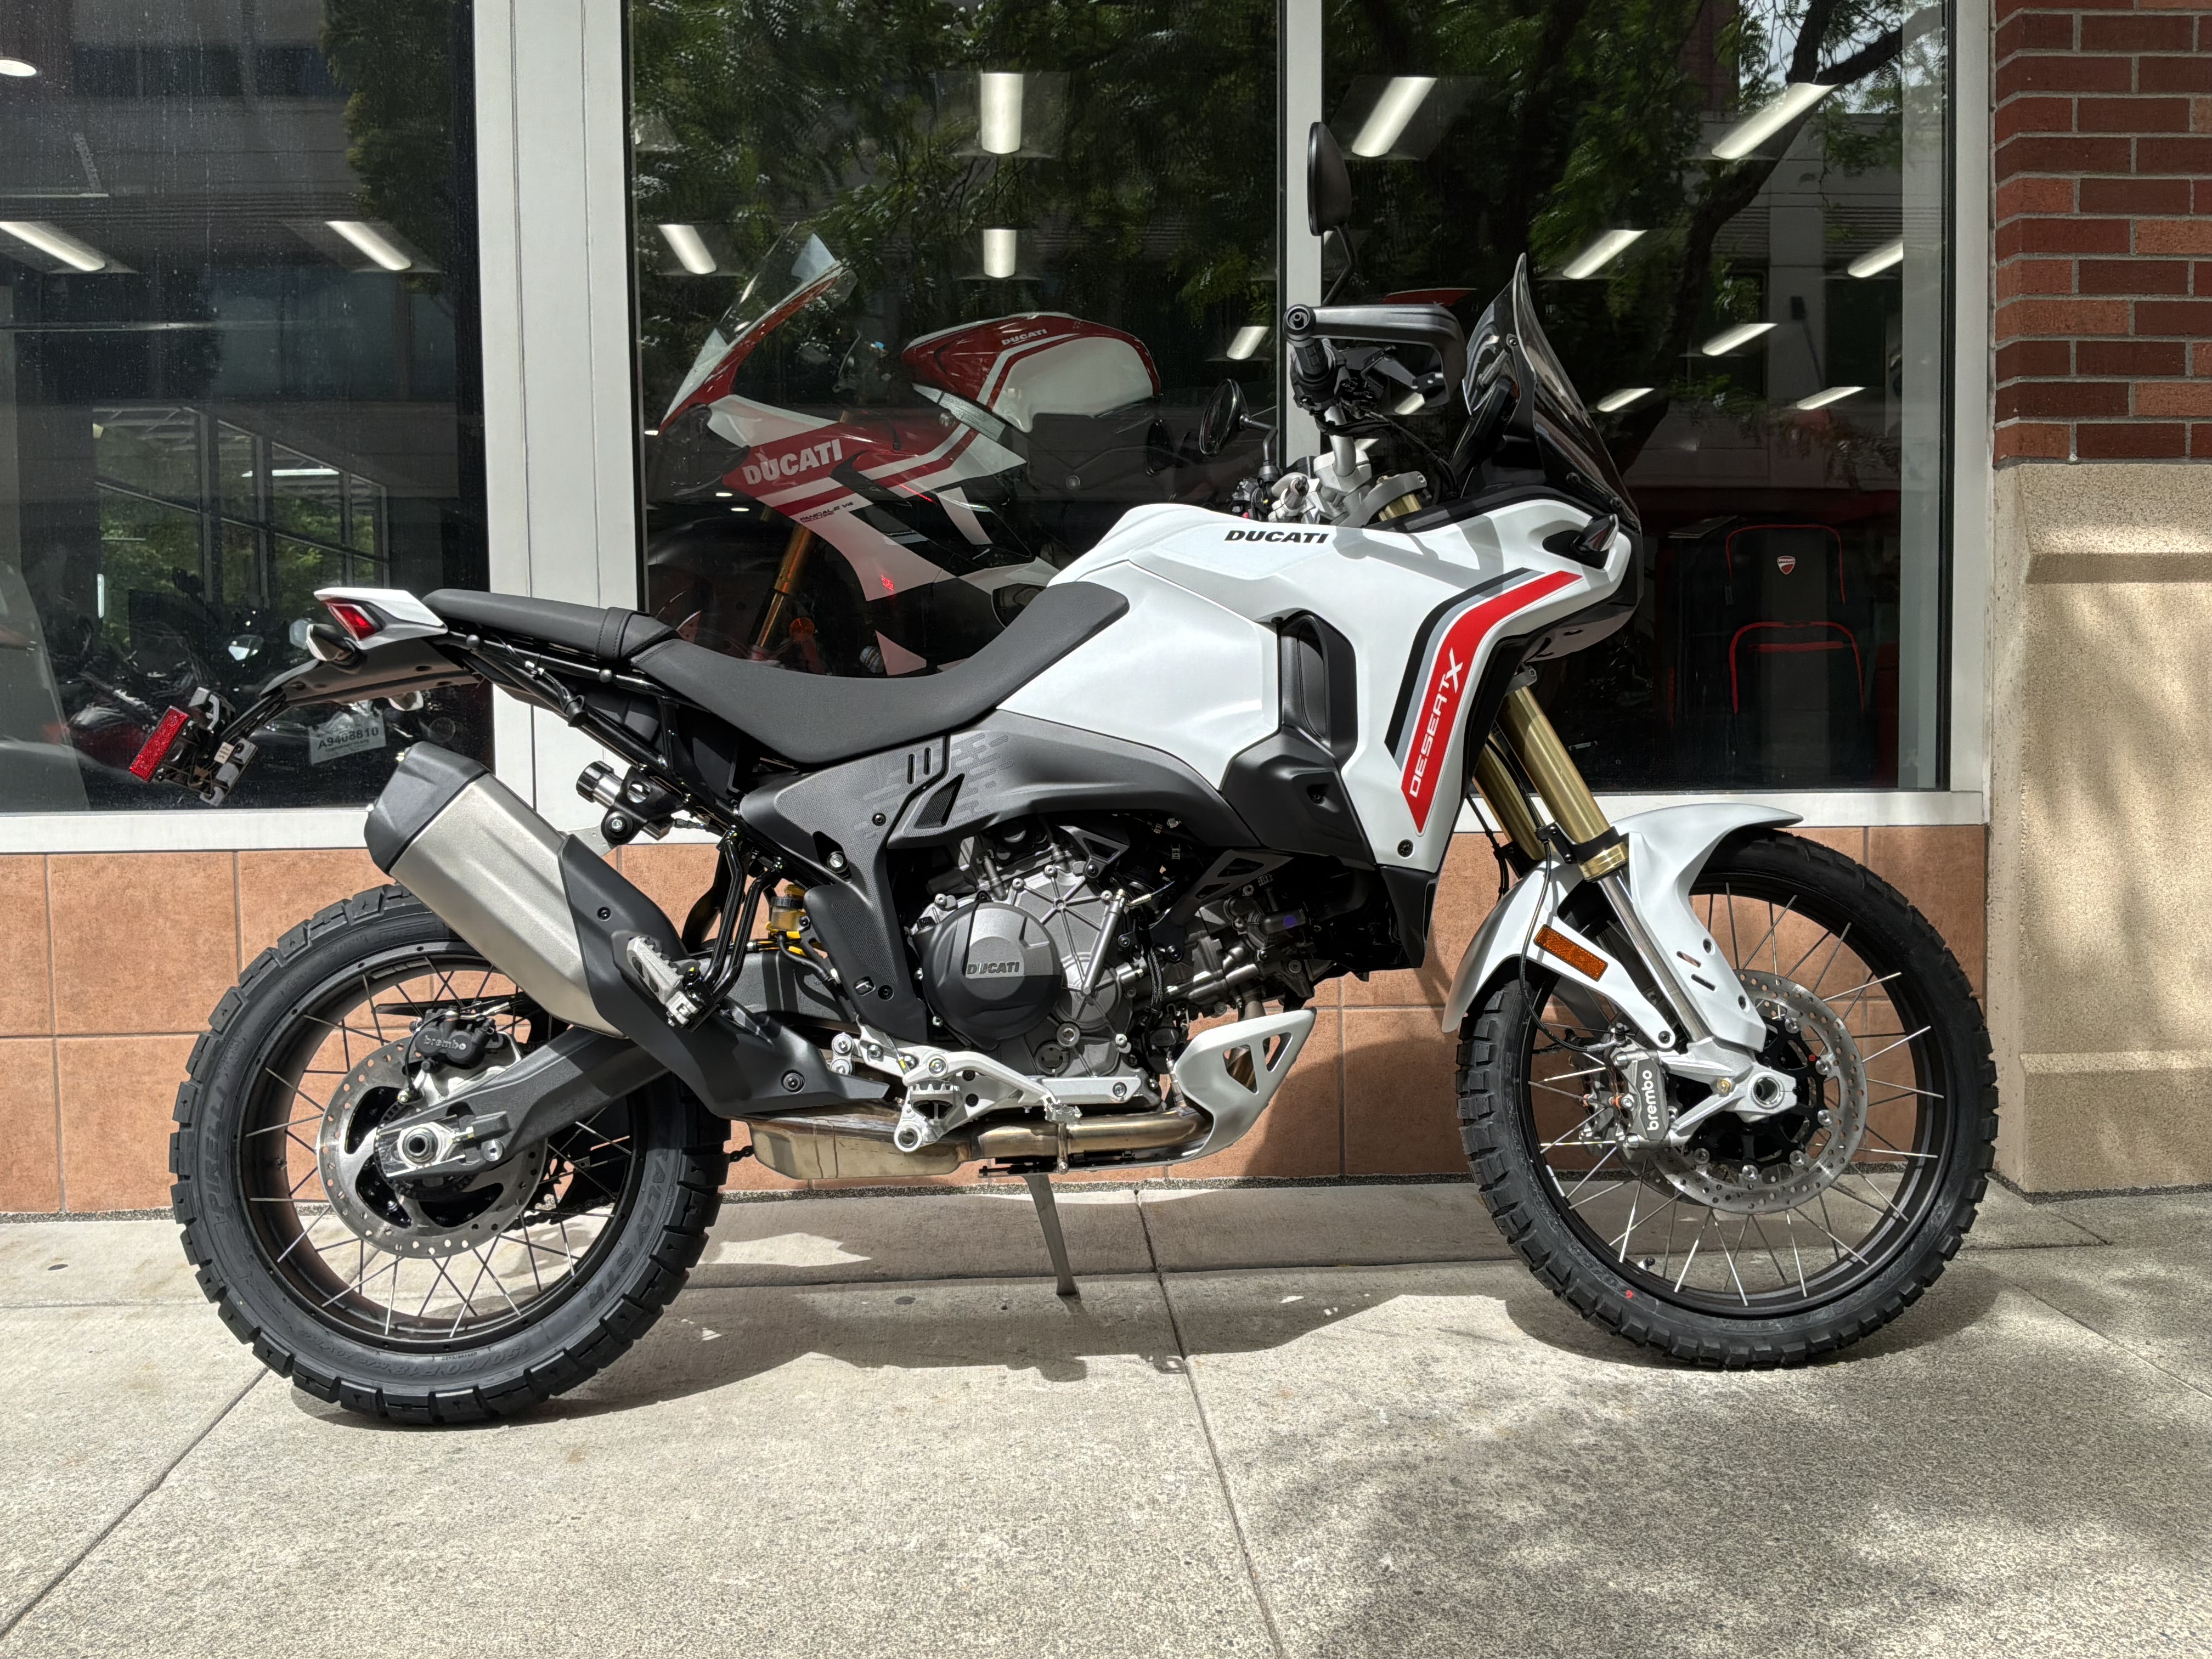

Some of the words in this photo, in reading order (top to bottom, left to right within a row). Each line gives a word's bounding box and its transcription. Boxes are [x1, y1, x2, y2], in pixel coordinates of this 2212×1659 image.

[1001, 329, 1047, 345] DUCATI
[742, 439, 843, 485] DUCATI
[800, 505, 840, 521] PANIGALE
[1224, 530, 1329, 543] DUCATI
[1409, 647, 1463, 798] DESERTX
[967, 962, 1019, 974] DUCATI
[424, 1035, 466, 1050] brembo
[1641, 1070, 1659, 1130] brembo
[205, 1086, 227, 1214] PIRELLI
